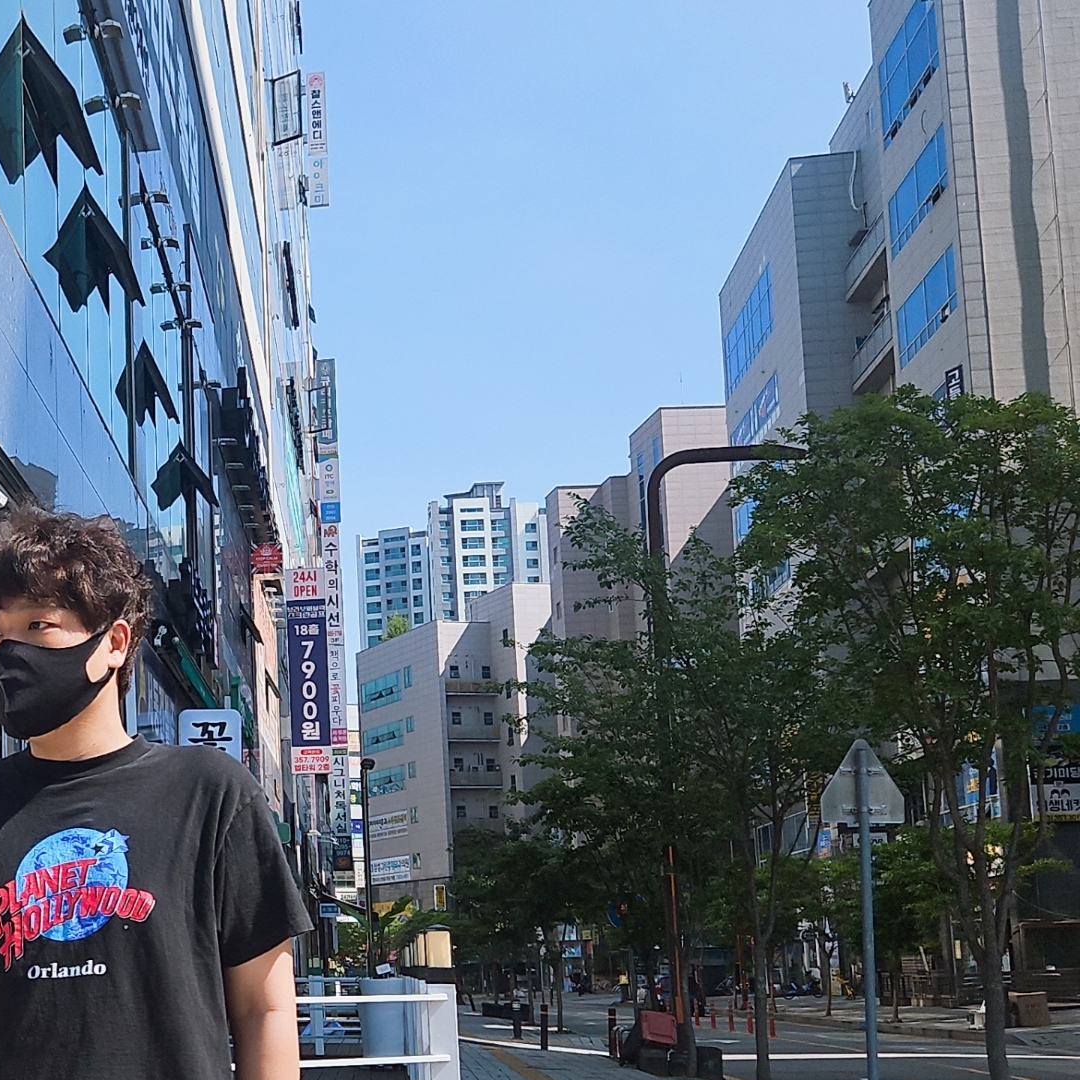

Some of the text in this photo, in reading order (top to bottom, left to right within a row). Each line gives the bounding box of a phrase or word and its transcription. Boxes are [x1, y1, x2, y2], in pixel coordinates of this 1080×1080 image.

[293, 570, 317, 583] 24시
[293, 585, 317, 597] OPEN
[300, 640, 321, 741] 7900원
[332, 756, 347, 834] 시그니처독서실
[27, 959, 107, 979] Orlando
